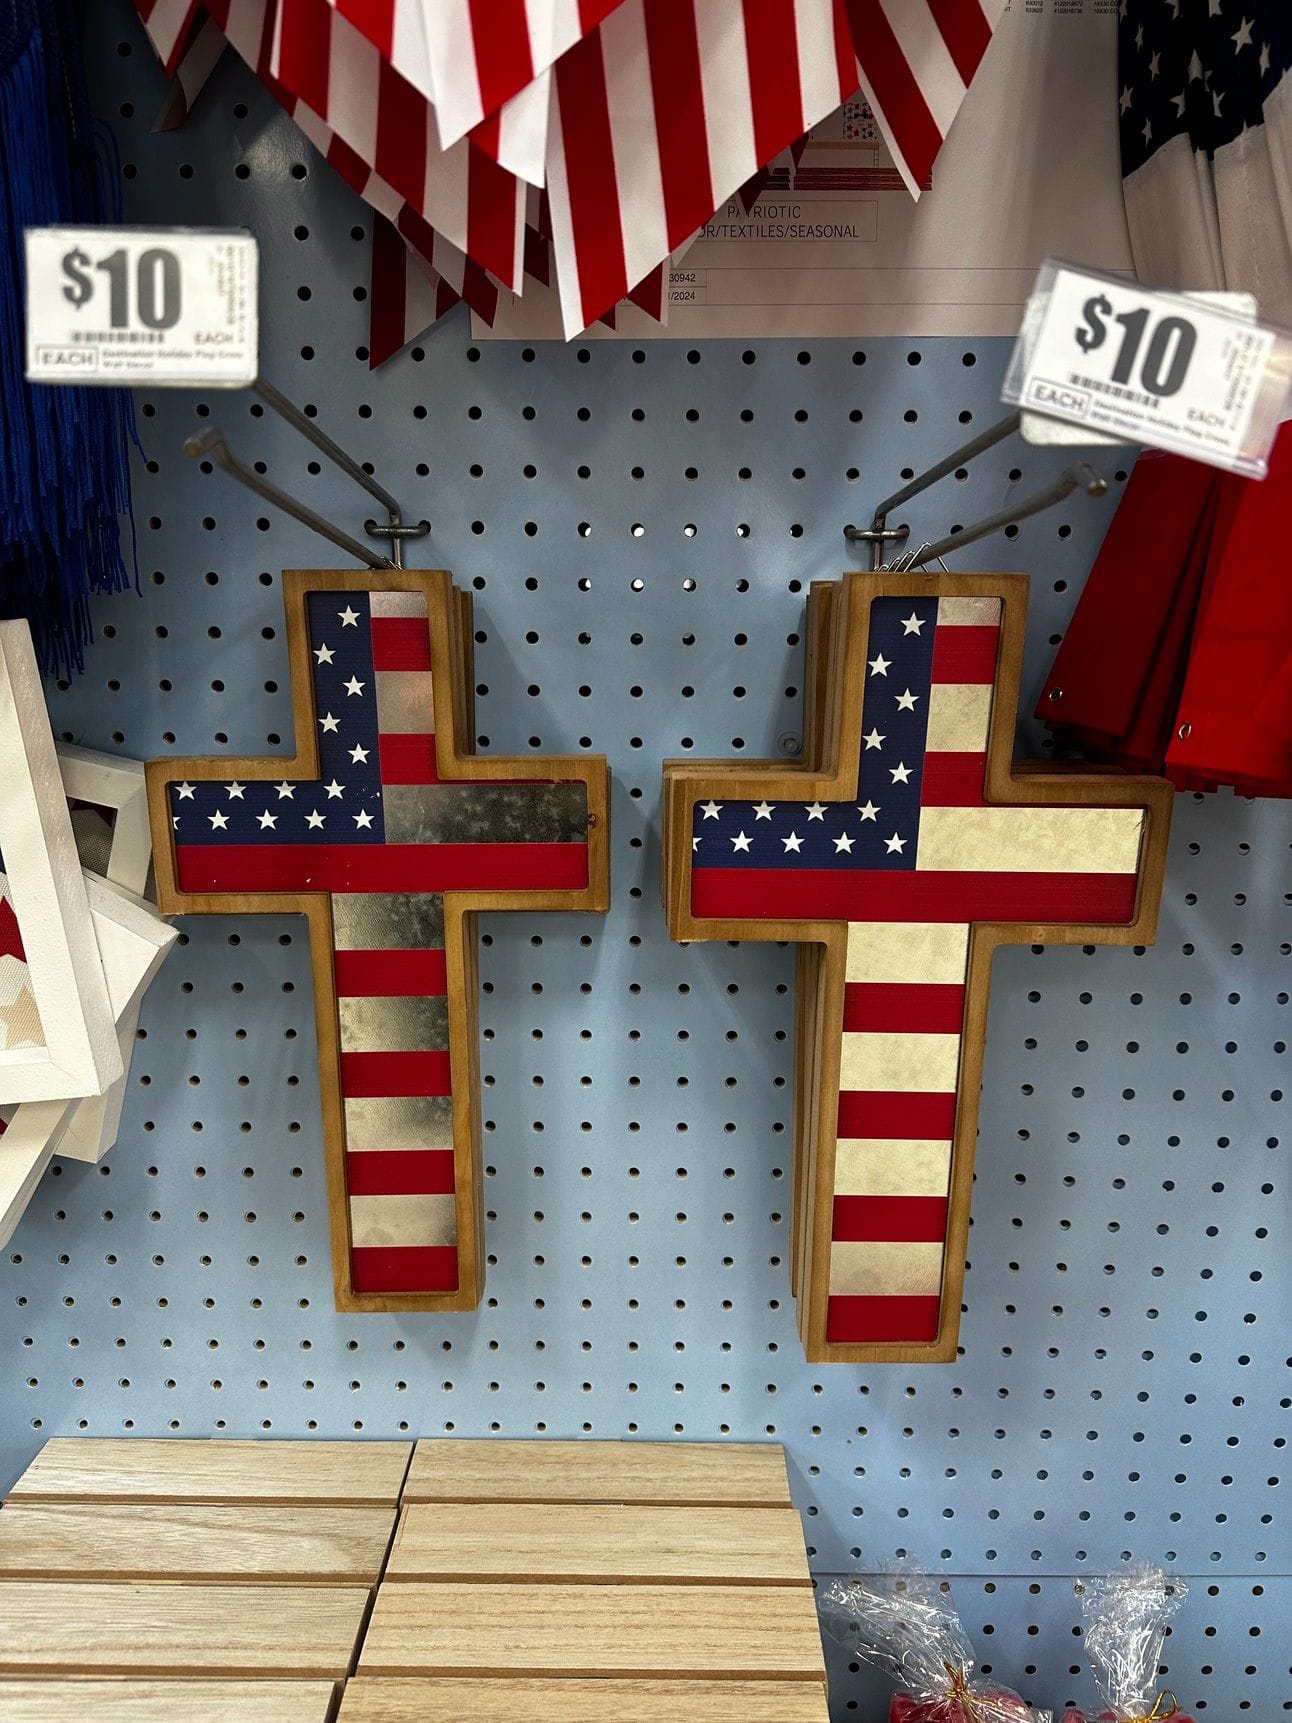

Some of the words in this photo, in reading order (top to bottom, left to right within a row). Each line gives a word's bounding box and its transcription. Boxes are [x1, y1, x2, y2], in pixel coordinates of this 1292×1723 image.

[727, 205, 801, 219] PRIOTIC
[62, 245, 182, 331] $10
[194, 332, 234, 344] EACH
[1075, 294, 1198, 397] $10
[42, 352, 93, 366] EACH
[1034, 386, 1086, 410] EACH
[1187, 407, 1226, 428] EACH
